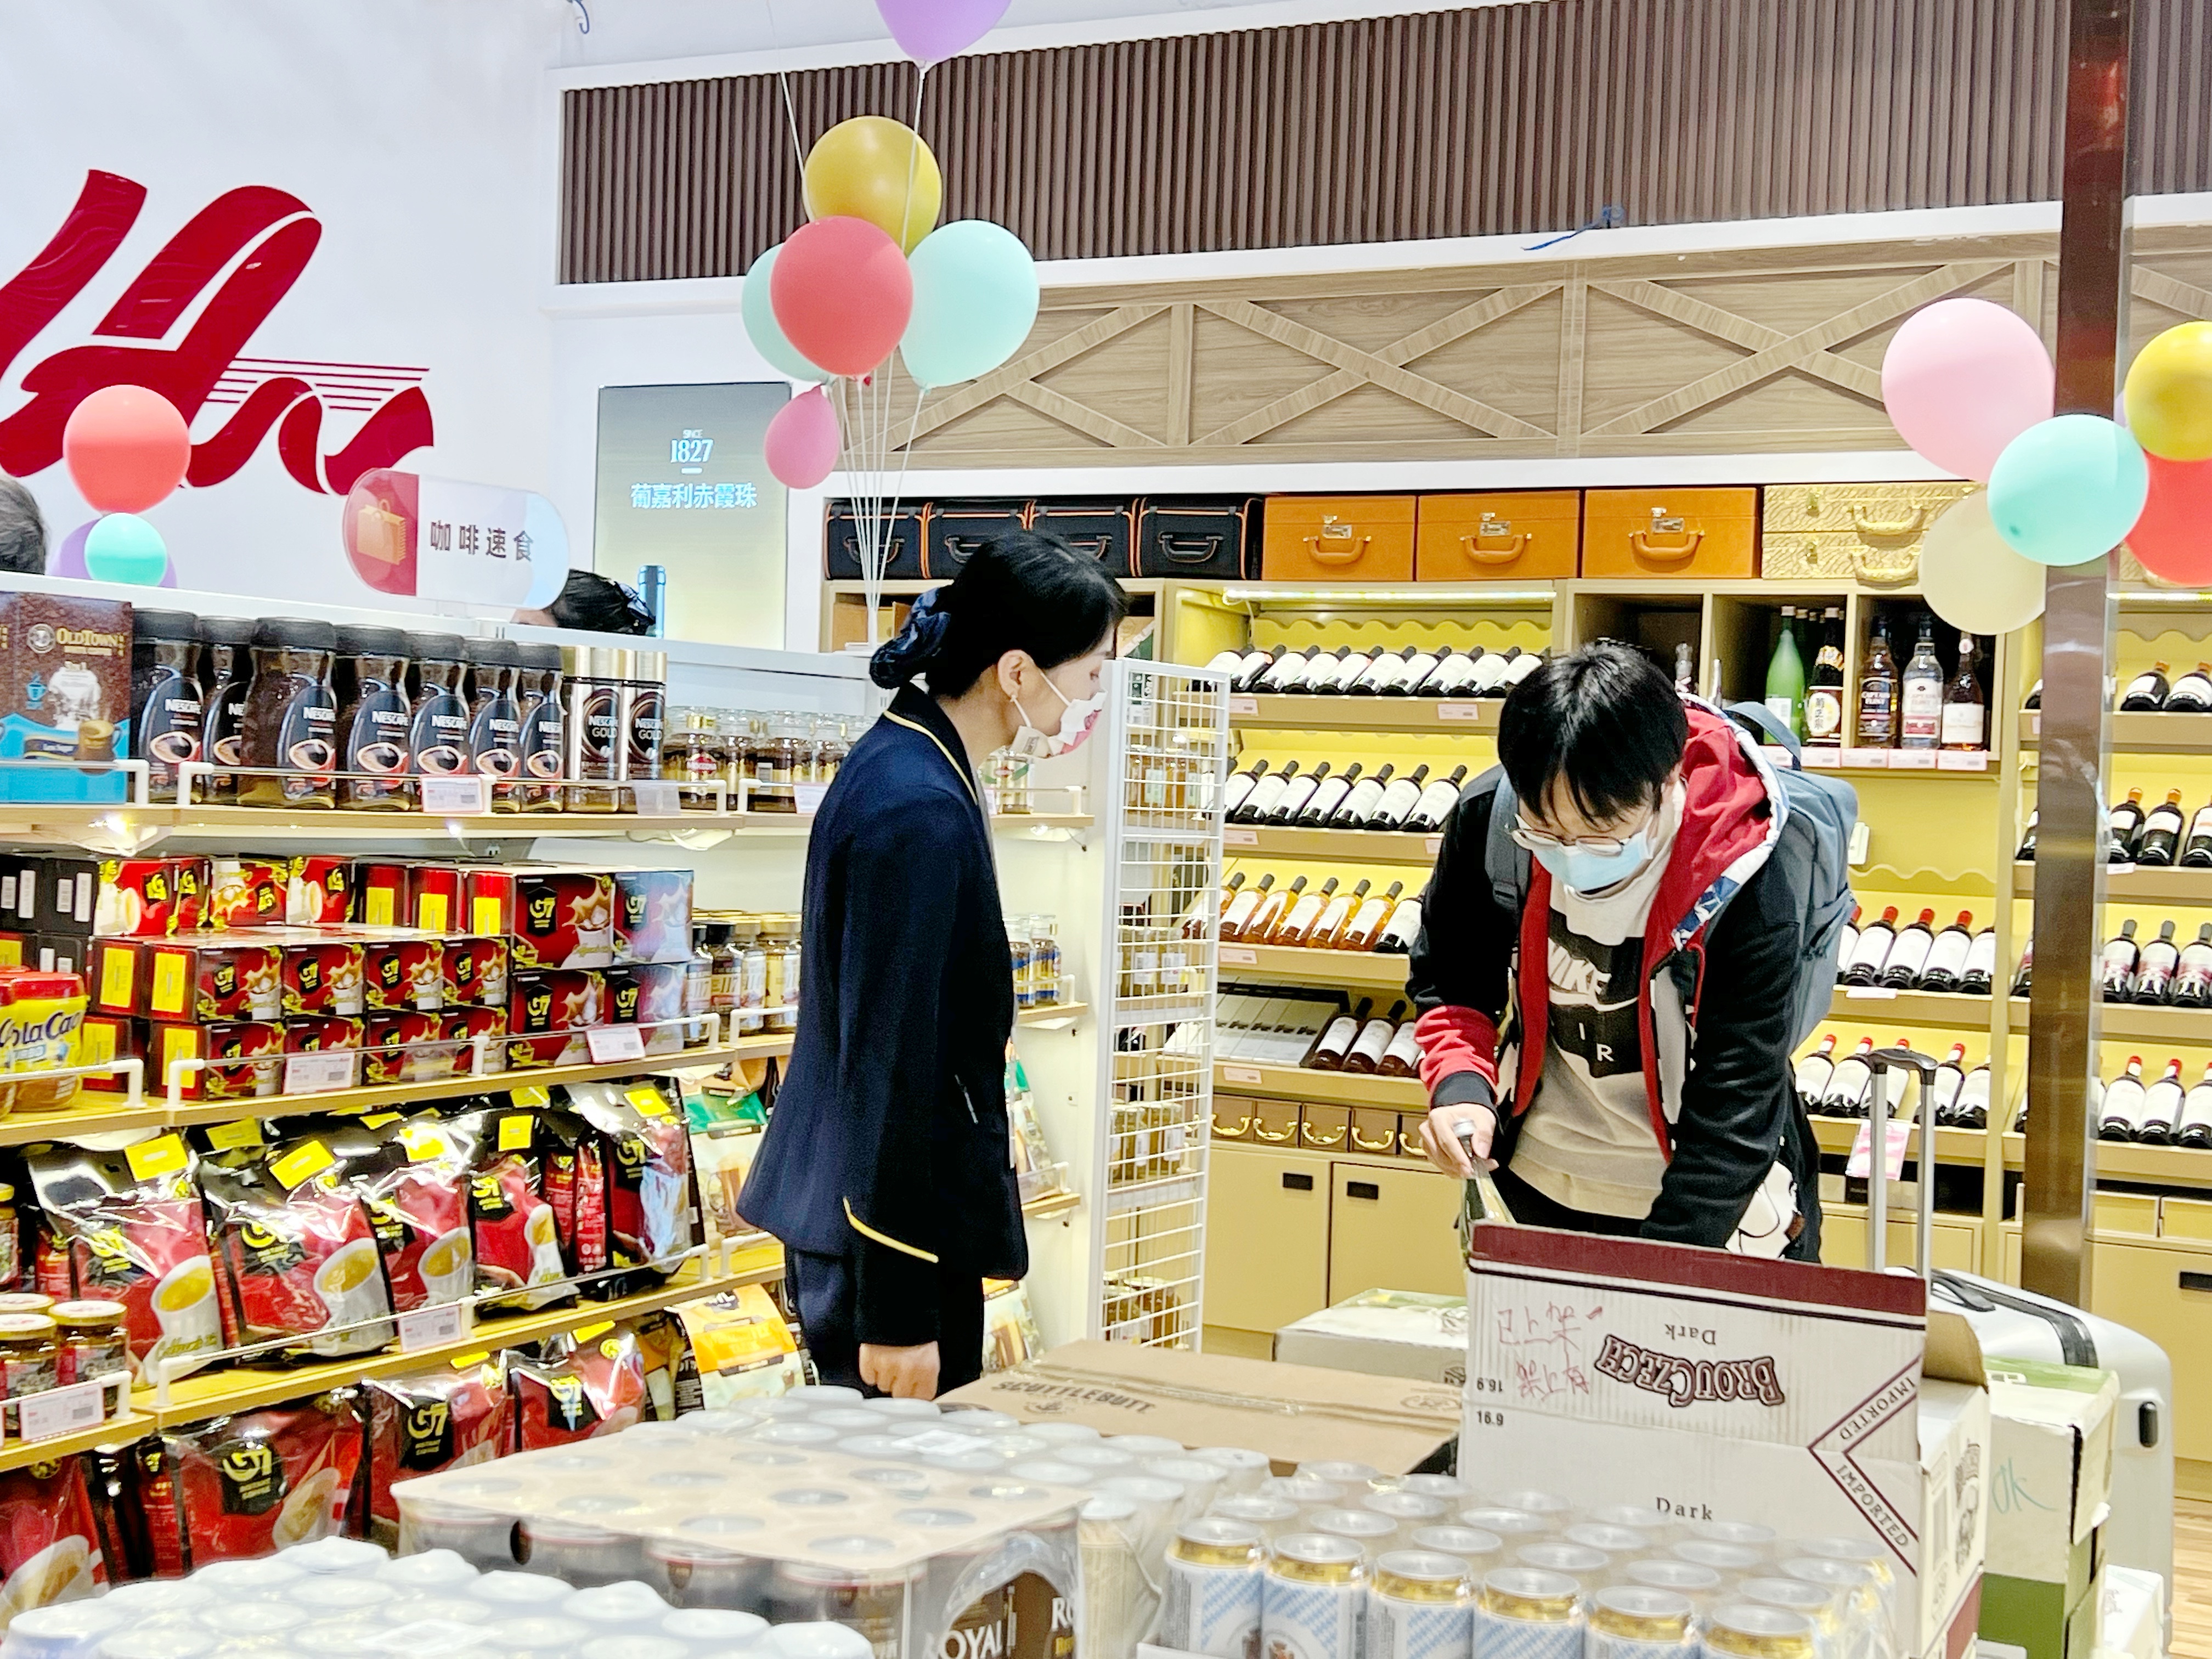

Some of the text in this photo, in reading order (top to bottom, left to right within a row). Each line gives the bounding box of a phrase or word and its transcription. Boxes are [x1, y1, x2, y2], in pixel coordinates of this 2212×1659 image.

[670, 439, 713, 462] 1827
[631, 482, 757, 509] 葡嘉利赤霞珠
[430, 520, 534, 563] 咖啡速食
[592, 727, 617, 738] GOLD
[639, 730, 662, 740] GOLD
[1664, 1323, 1717, 1346] Dark
[1594, 1334, 1785, 1407] BROUCZECH
[991, 1381, 1155, 1414] SCUTTLEBUTT
[1839, 1376, 1916, 1440] IMPORTED
[408, 1401, 448, 1439] G7
[1476, 1409, 1504, 1426] 16.9
[222, 1445, 272, 1481] G7
[1656, 1497, 1713, 1521] Dark
[1836, 1464, 1909, 1547] IMPORTED
